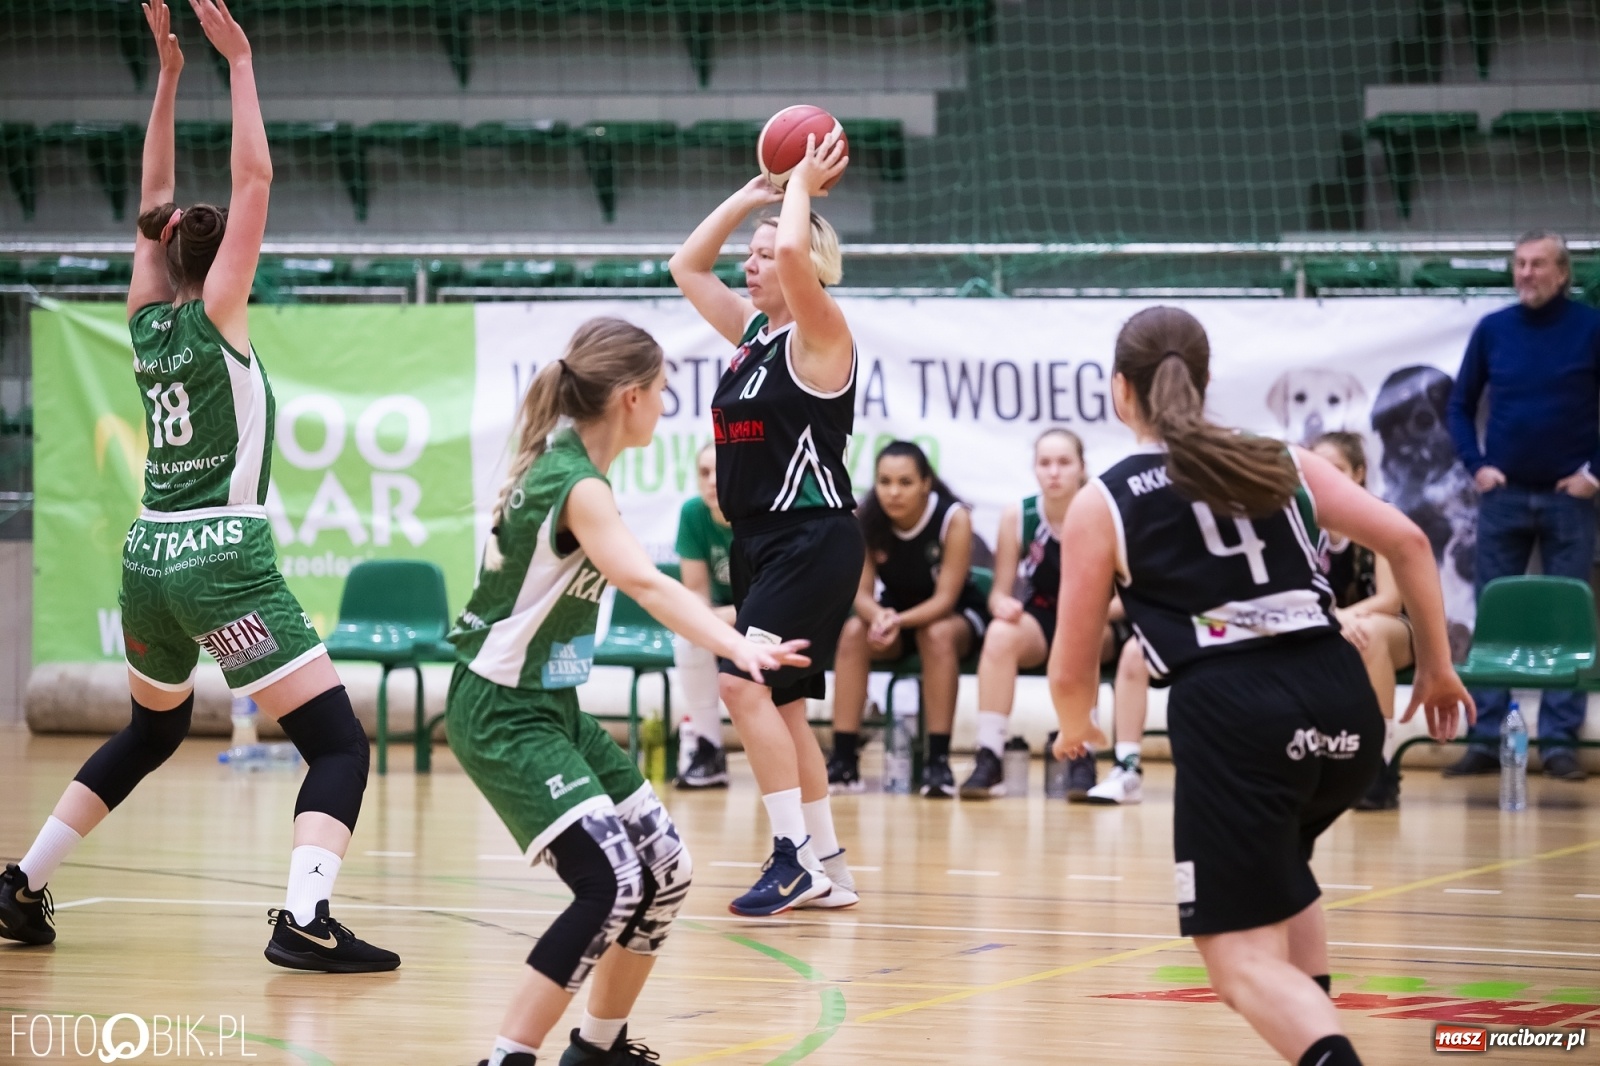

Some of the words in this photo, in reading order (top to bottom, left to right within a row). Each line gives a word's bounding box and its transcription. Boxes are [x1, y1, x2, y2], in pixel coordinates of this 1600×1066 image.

[146, 382, 194, 448] 18
[910, 357, 1109, 423] TWOJEG
[274, 394, 431, 471] OO
[1191, 501, 1270, 585] 4
